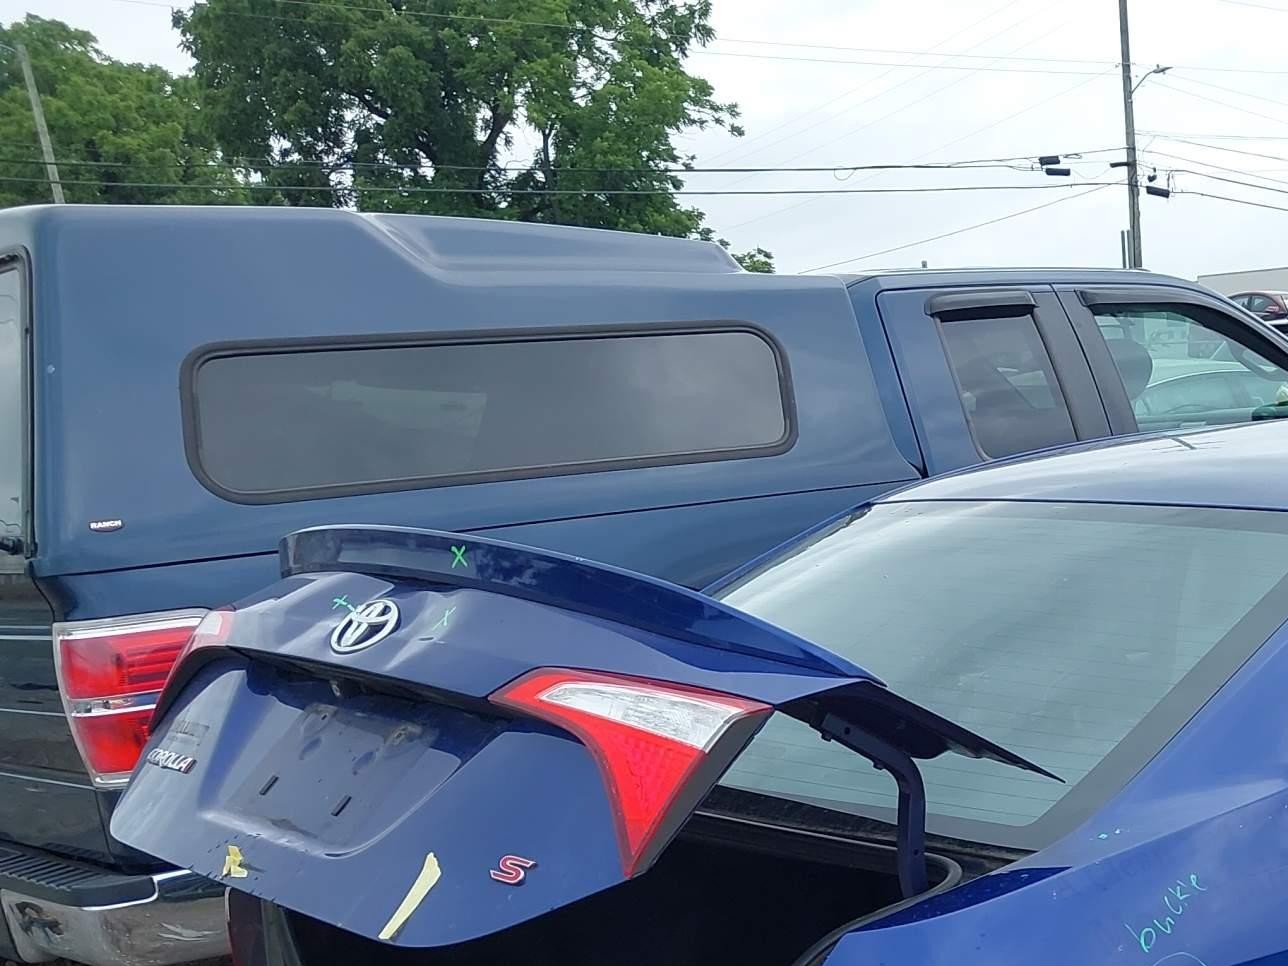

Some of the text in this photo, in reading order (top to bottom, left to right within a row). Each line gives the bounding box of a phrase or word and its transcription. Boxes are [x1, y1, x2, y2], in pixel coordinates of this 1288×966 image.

[90, 519, 122, 529] RANCH
[146, 747, 196, 773] COROLLA
[489, 855, 537, 884] S
